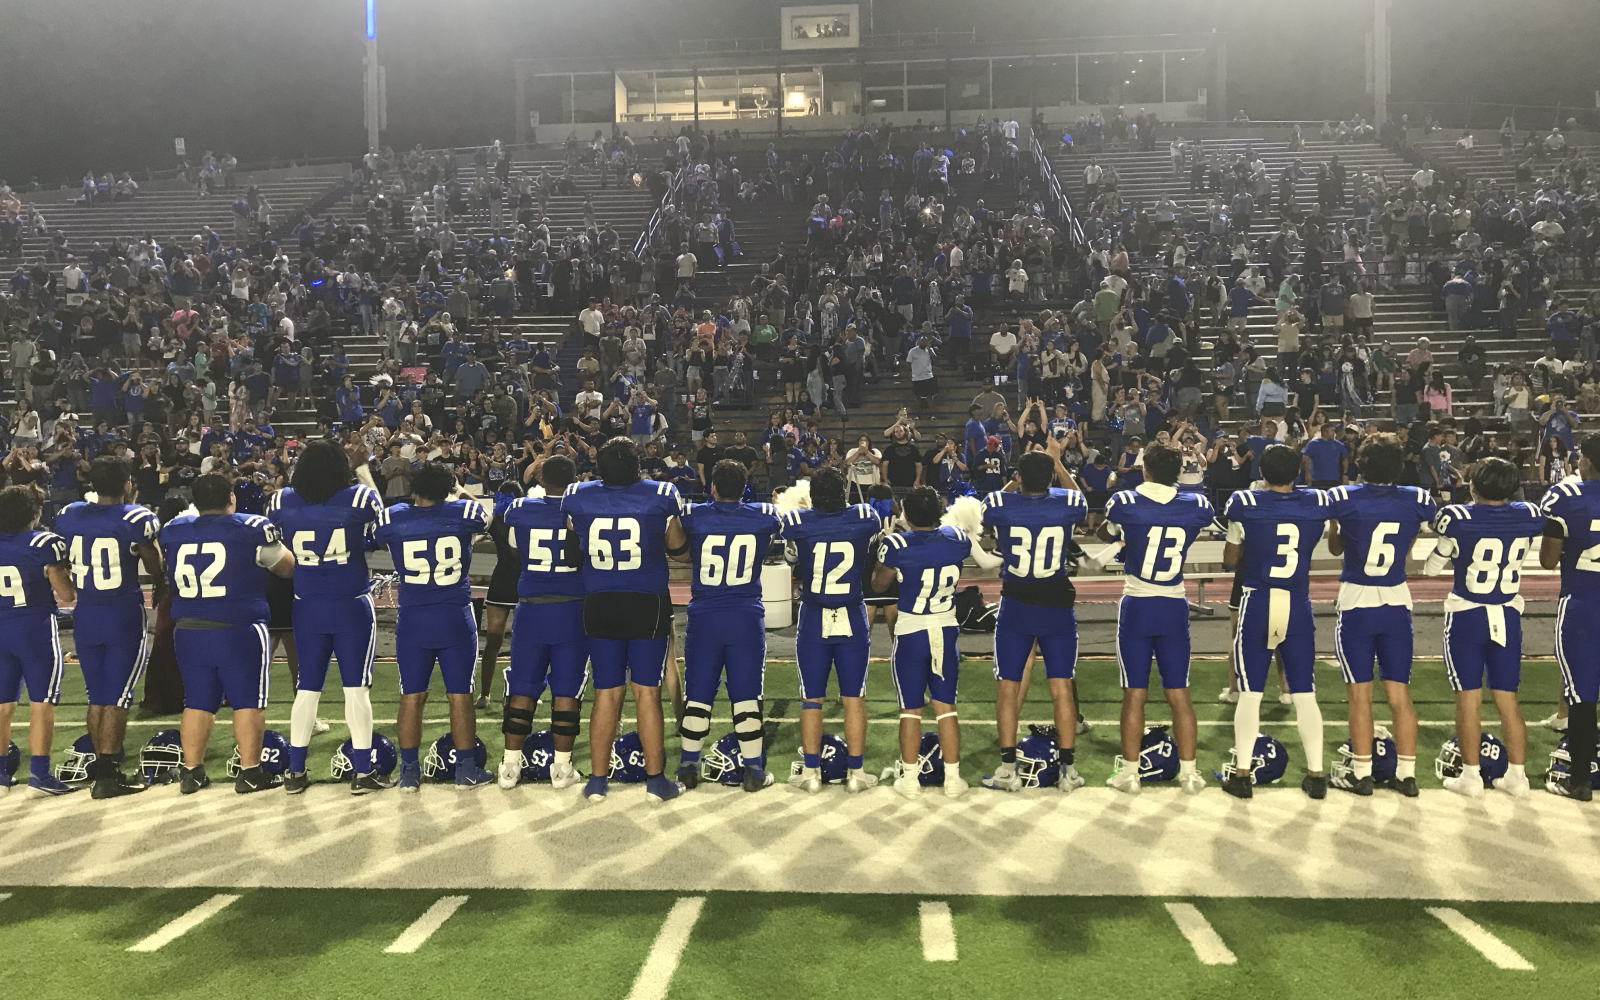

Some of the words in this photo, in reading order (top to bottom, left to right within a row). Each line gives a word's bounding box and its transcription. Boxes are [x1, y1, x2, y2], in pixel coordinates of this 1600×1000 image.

[68, 535, 122, 590] 40
[175, 542, 226, 598] 62
[403, 536, 462, 585] 58
[589, 518, 641, 570] 63
[700, 534, 756, 586] 60
[811, 542, 854, 594] 12
[1008, 526, 1064, 578] 30
[1143, 526, 1190, 581] 13
[1270, 523, 1299, 578] 3
[1364, 522, 1400, 576] 6
[1466, 537, 1530, 594] 88
[912, 565, 960, 614] 18
[260, 747, 280, 763] 62
[531, 749, 549, 767] 53
[1266, 743, 1276, 759] 3
[1376, 742, 1386, 756] 6
